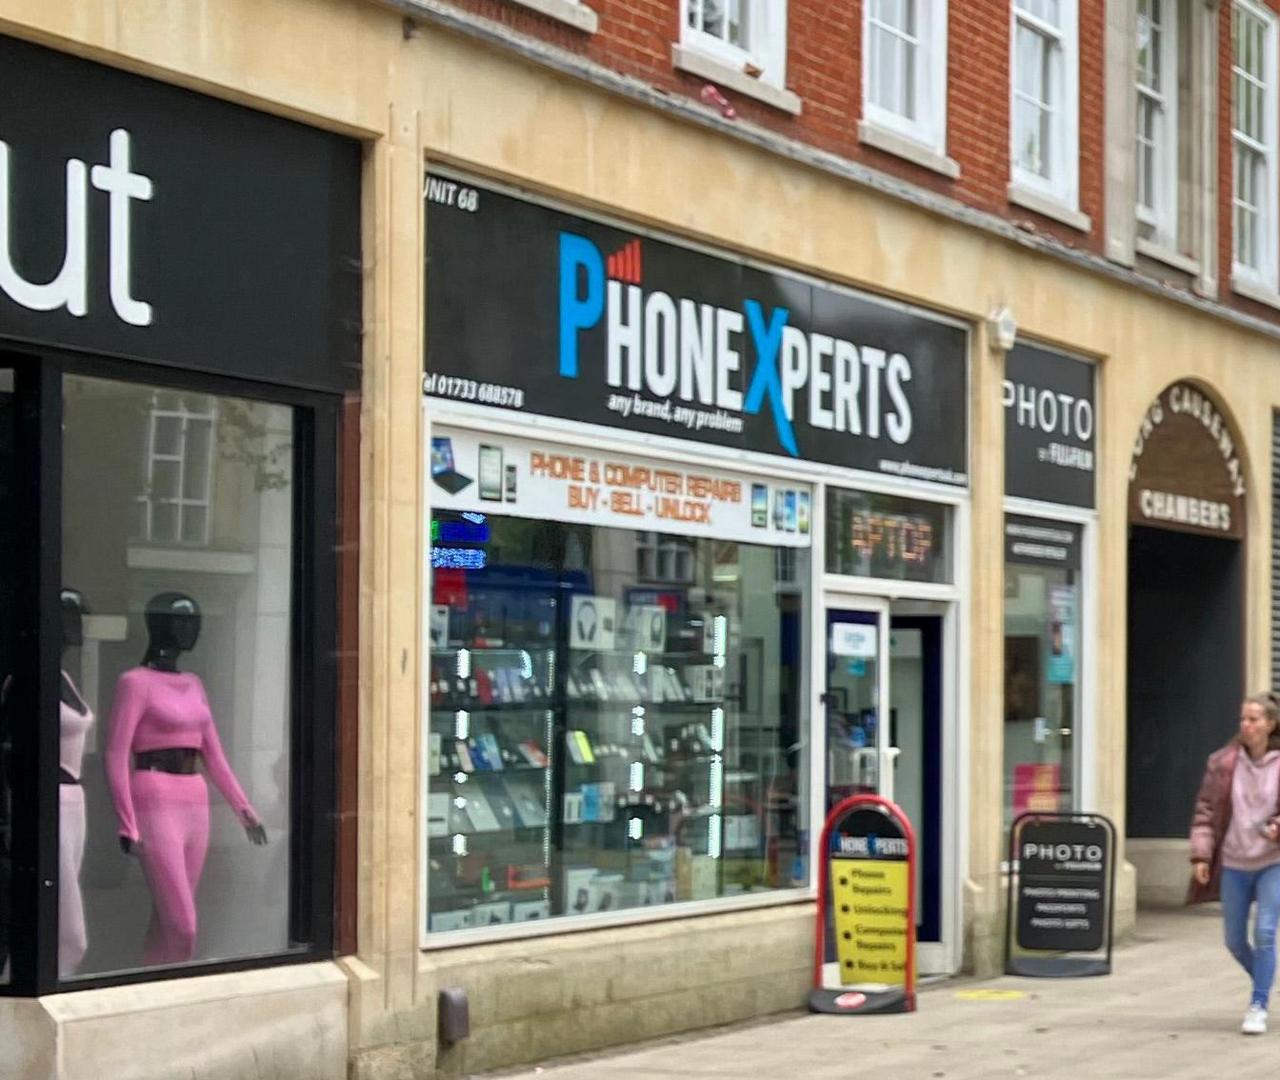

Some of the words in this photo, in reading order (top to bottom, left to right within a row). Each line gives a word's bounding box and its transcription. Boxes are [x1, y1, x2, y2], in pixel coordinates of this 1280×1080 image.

[458, 188, 479, 212] 68
[559, 231, 913, 456] PHONEXPERTS
[438, 376, 476, 400] 01733
[608, 393, 632, 417] any
[673, 405, 696, 428] any
[695, 410, 744, 433] problem
[1000, 379, 1092, 441] PHOTO
[1169, 386, 1246, 496] CAUSEWAY
[530, 452, 585, 482] PHONE
[604, 463, 683, 495] COMPUTER
[686, 474, 742, 503] REPAIRS
[568, 485, 600, 511] BUY
[611, 491, 644, 516] SELL
[655, 496, 711, 524] UNLOCK
[1140, 489, 1230, 531] CHAMBERS
[1024, 843, 1102, 861] PHOTO
